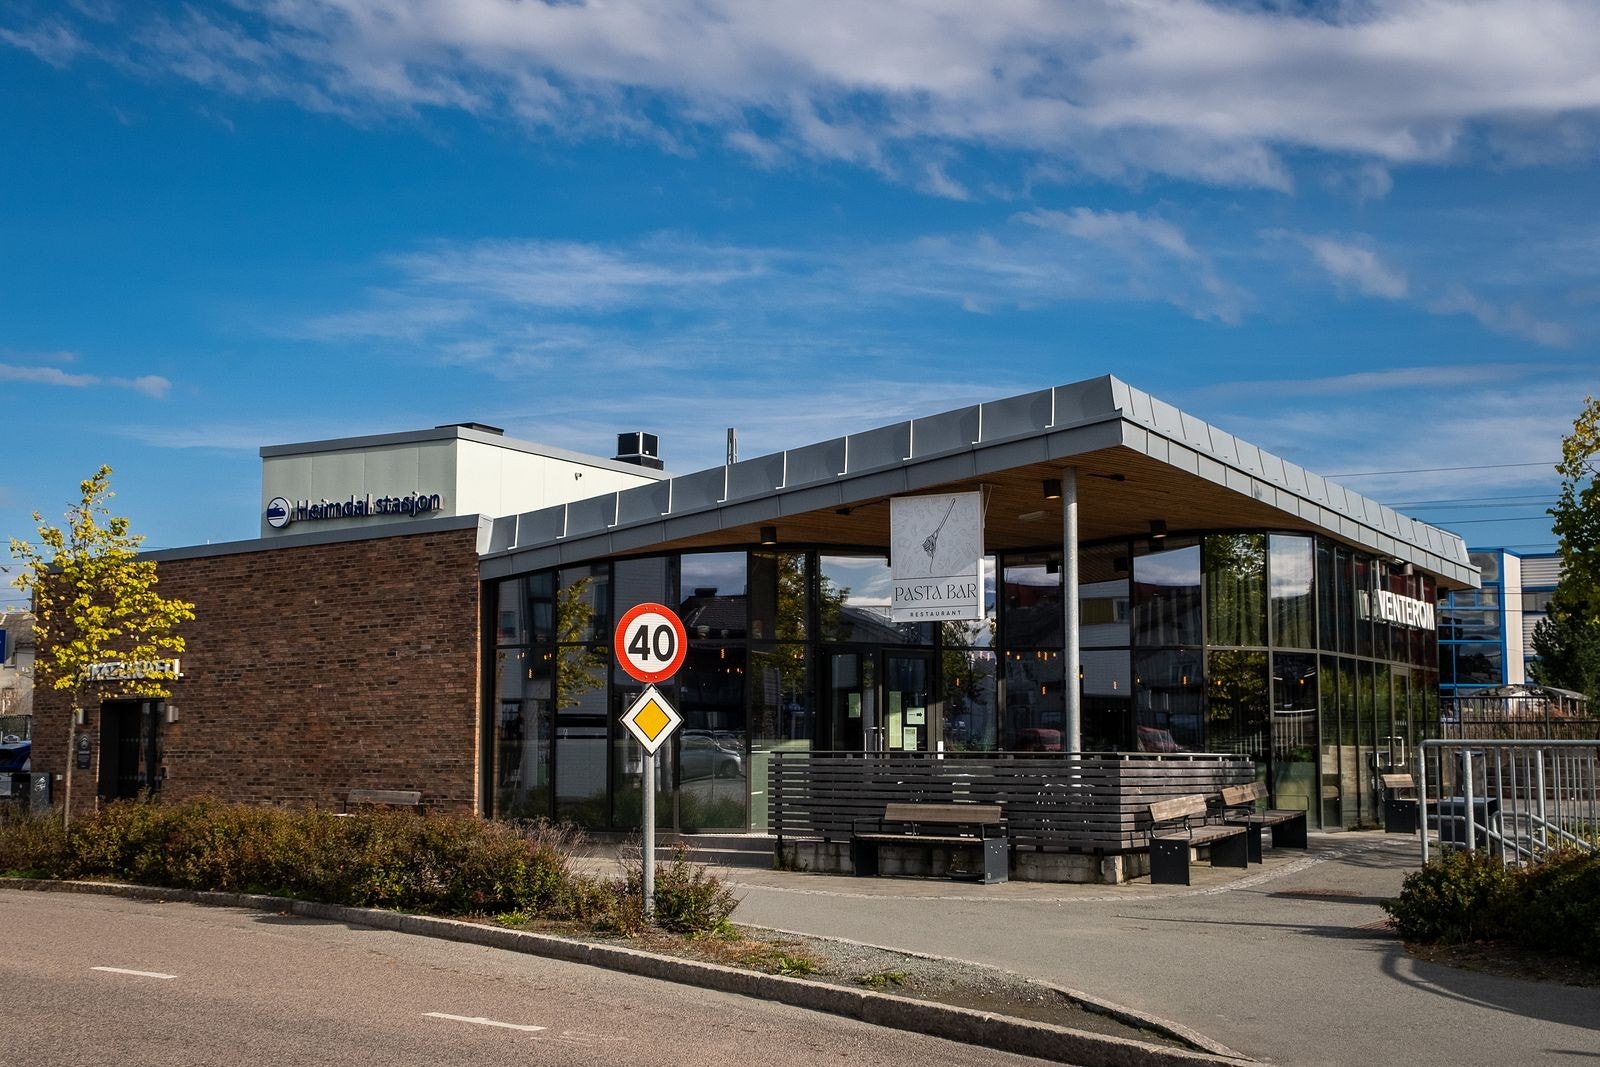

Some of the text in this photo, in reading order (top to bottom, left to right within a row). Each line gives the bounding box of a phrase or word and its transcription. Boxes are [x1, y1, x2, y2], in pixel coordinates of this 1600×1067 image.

[296, 490, 442, 521] Heimdal stasjon
[895, 583, 977, 601] PASTA BAR
[910, 609, 962, 617] RESTAURANT
[1377, 588, 1436, 631] VENTEROM
[628, 624, 675, 662] 40
